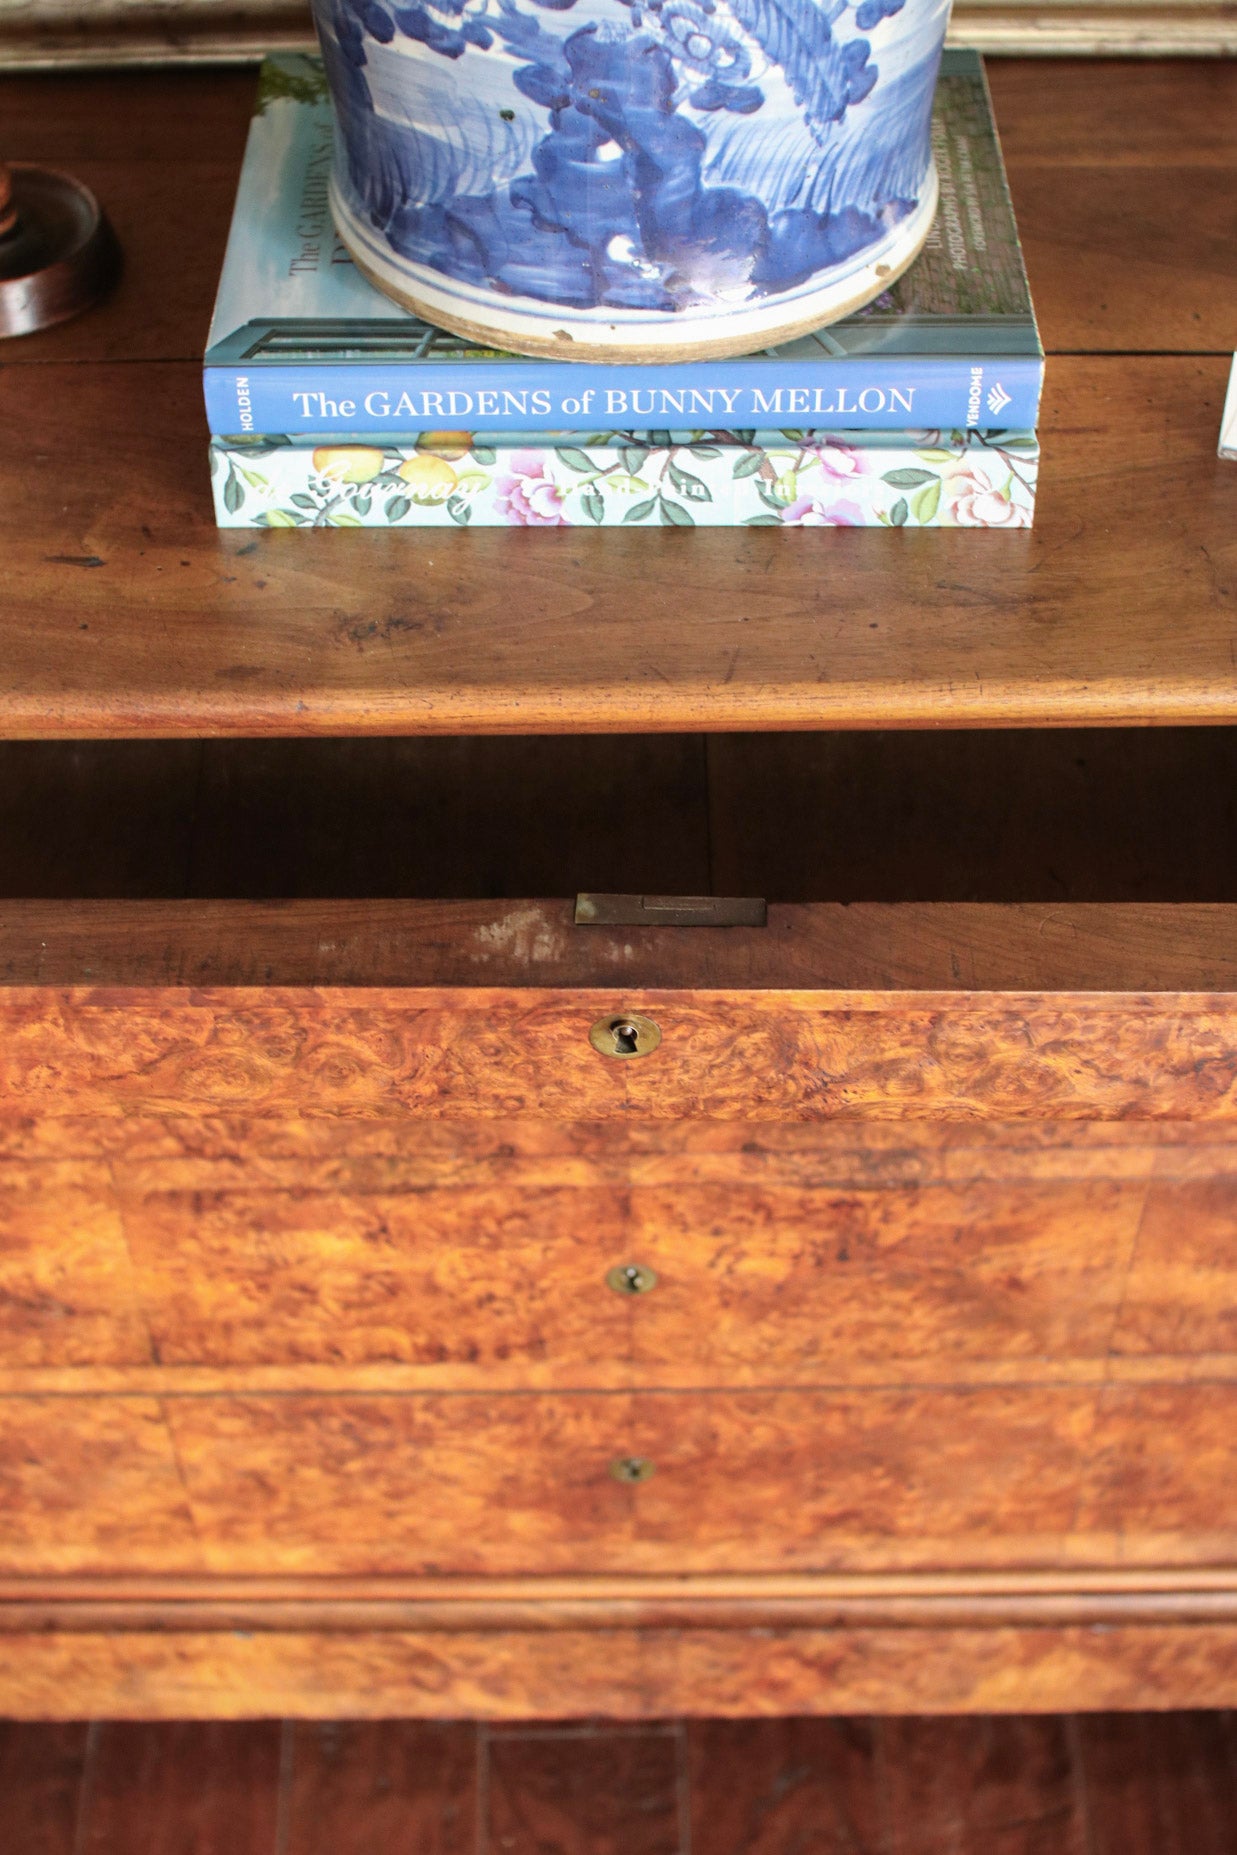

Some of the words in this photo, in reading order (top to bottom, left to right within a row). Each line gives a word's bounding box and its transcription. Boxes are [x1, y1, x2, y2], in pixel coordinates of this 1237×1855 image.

[297, 143, 333, 239] GARDENS
[289, 243, 320, 277] The
[942, 196, 968, 270] PHOTOGRAPHS
[236, 377, 253, 431] HOLDEN
[293, 391, 356, 418] The
[364, 389, 551, 417] GARDENS
[561, 388, 595, 415] of
[605, 387, 741, 415] BUNNY
[751, 386, 916, 414] MELLON
[966, 367, 983, 427] VENDOME
